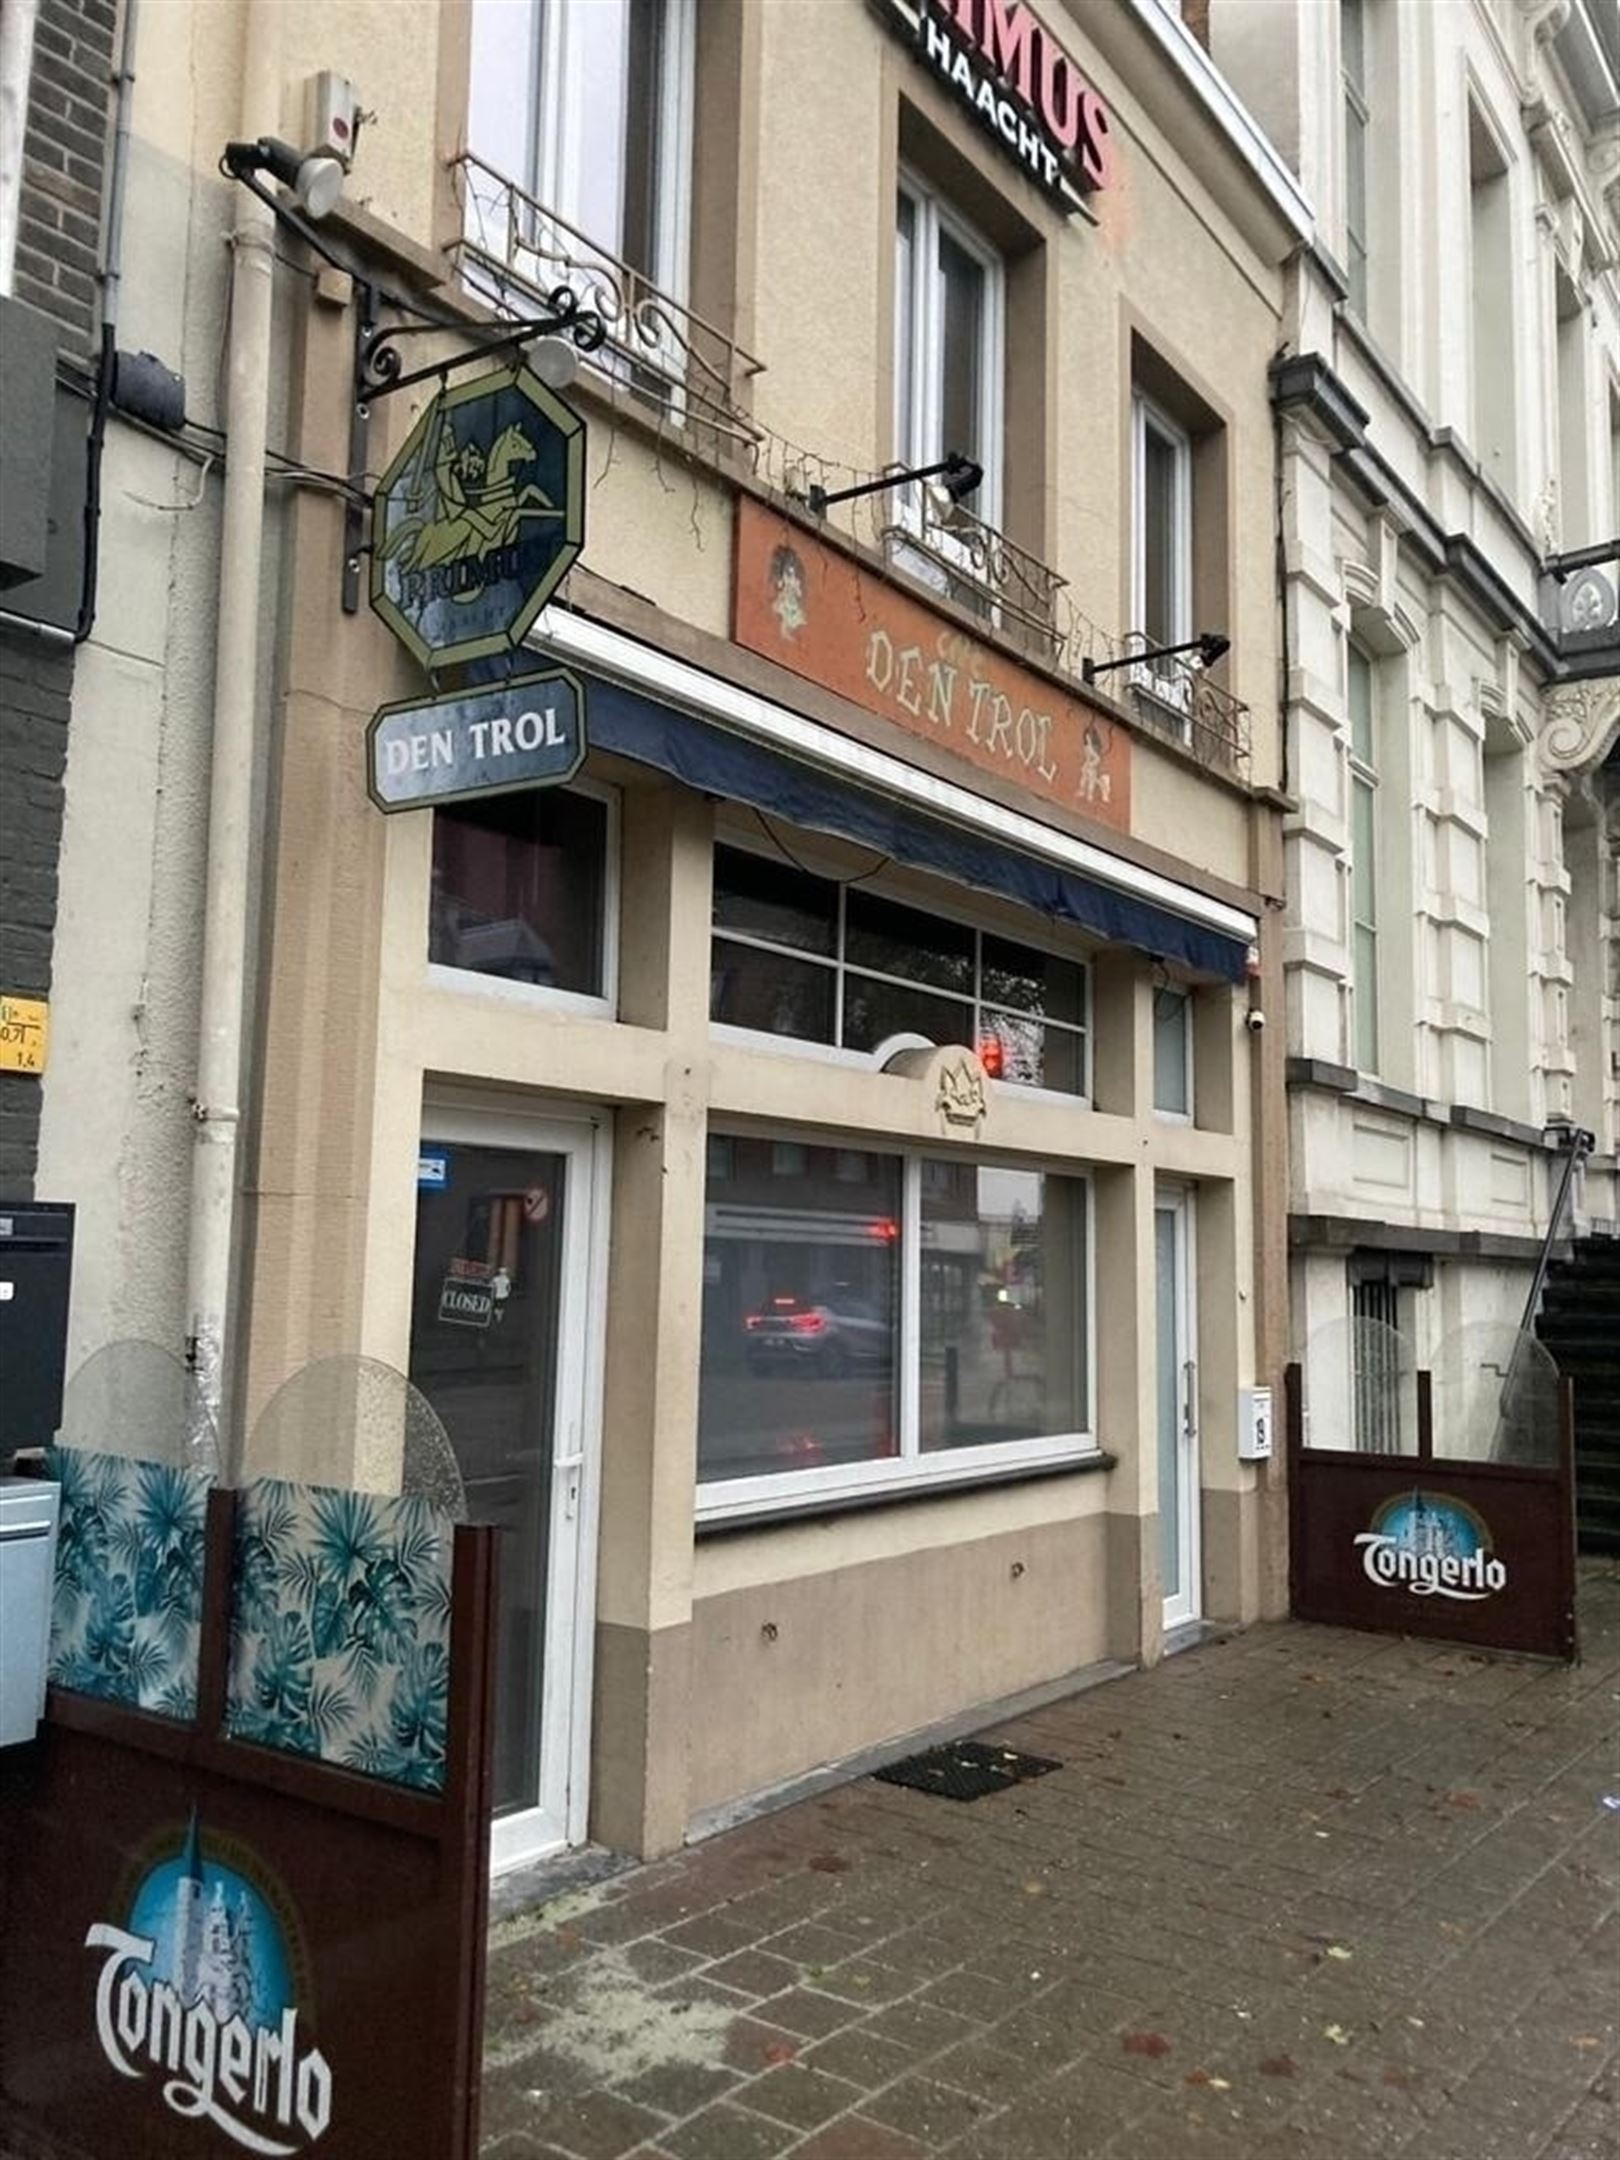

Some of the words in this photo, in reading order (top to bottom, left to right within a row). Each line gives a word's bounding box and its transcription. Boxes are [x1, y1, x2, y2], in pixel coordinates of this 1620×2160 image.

[927, 16, 1058, 185] HAACHT
[385, 729, 453, 775] DEN
[468, 708, 566, 759] TROL
[866, 630, 957, 727] DEN
[967, 674, 1057, 781] TROL
[1353, 1532, 1507, 1600] Tongerlo
[85, 1922, 333, 2156] Tongerlo
